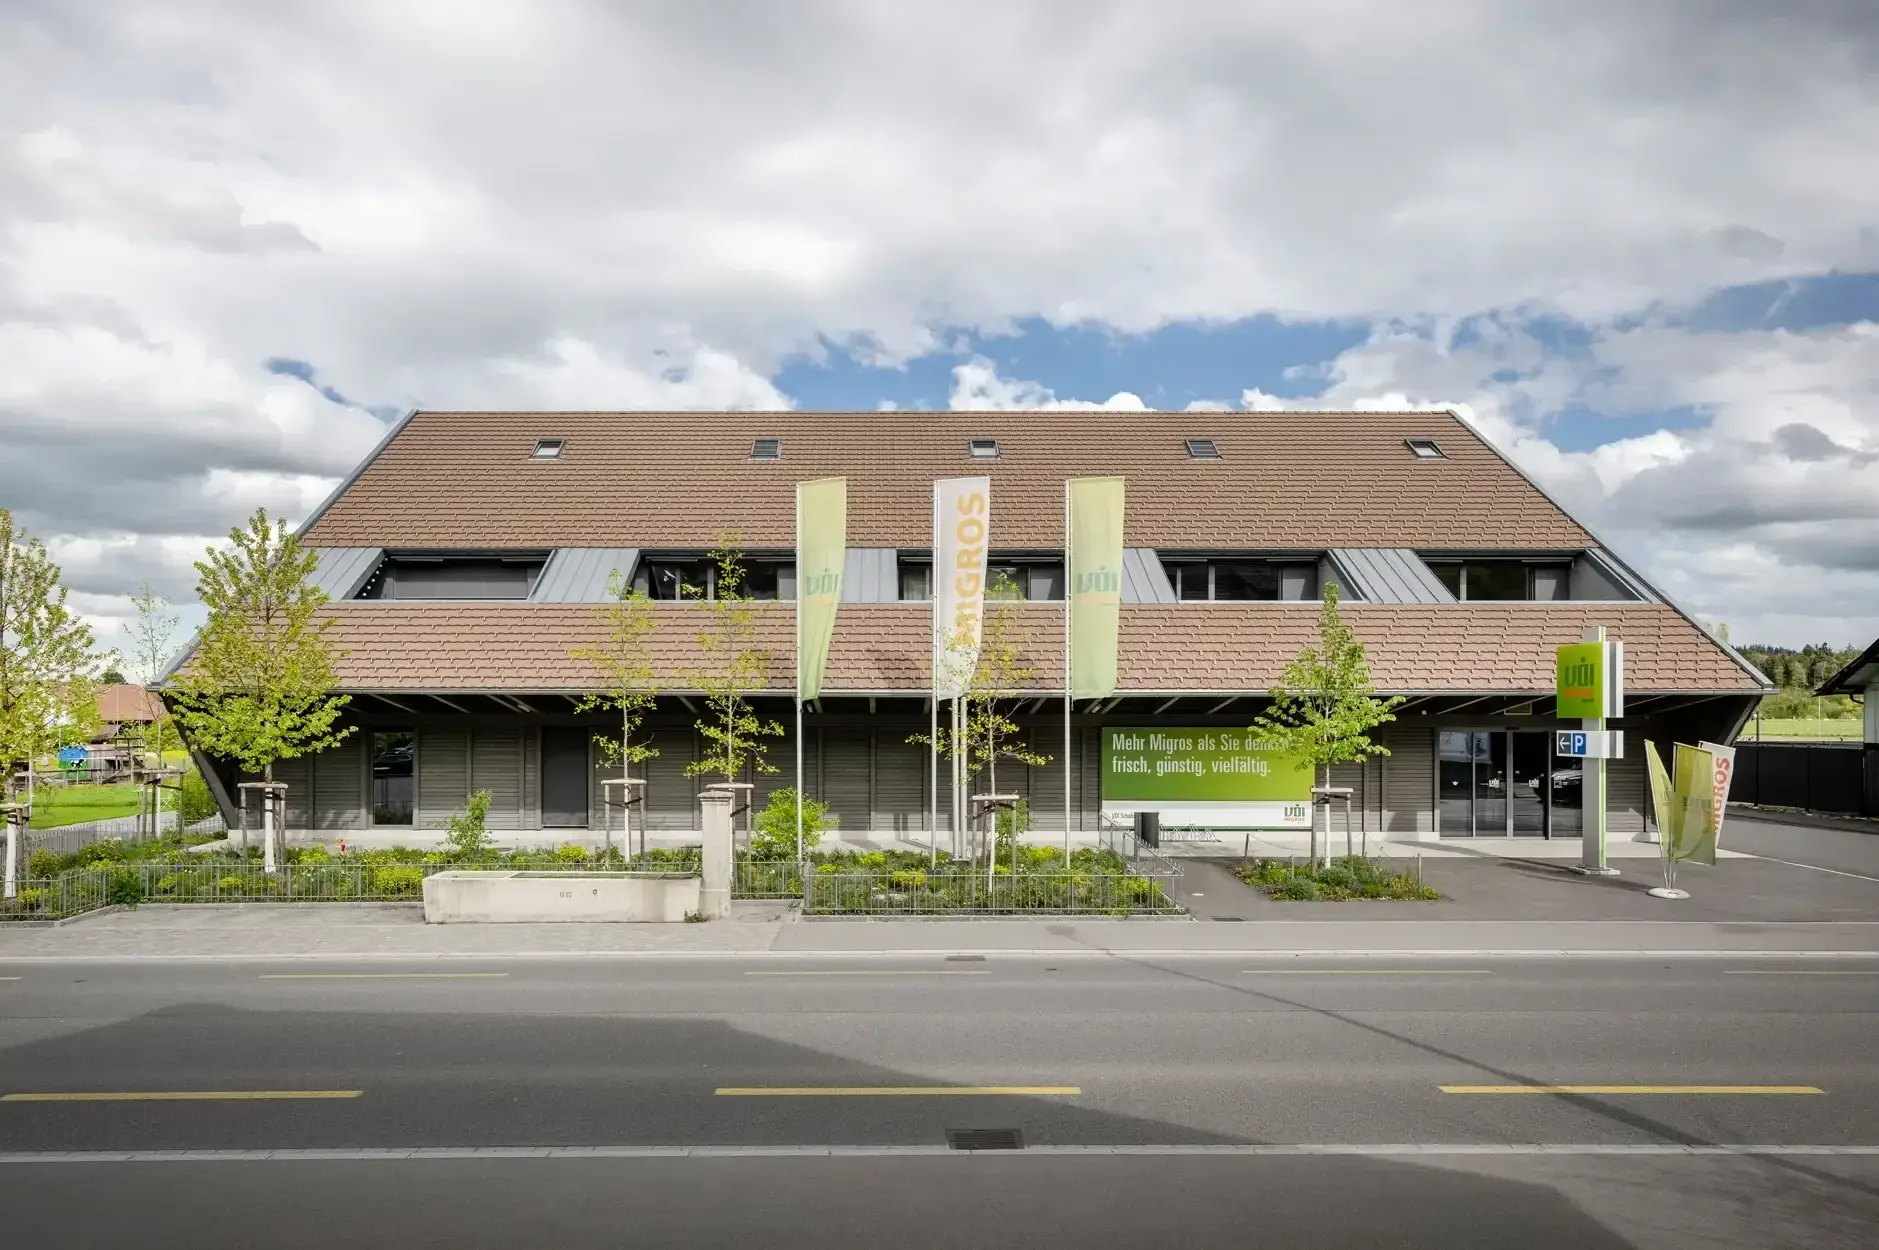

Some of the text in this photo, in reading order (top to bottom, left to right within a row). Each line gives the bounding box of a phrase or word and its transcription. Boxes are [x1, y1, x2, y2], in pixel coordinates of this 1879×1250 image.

[952, 491, 985, 645] MIGROS
[1112, 733, 1145, 751] Mehr
[1149, 733, 1193, 755] Migros
[1198, 733, 1216, 751] als
[1220, 733, 1240, 751] Sie
[1574, 735, 1584, 753] P
[1112, 756, 1272, 777] frisch, günstig, vielfältig.
[1712, 757, 1731, 834] IGROS
